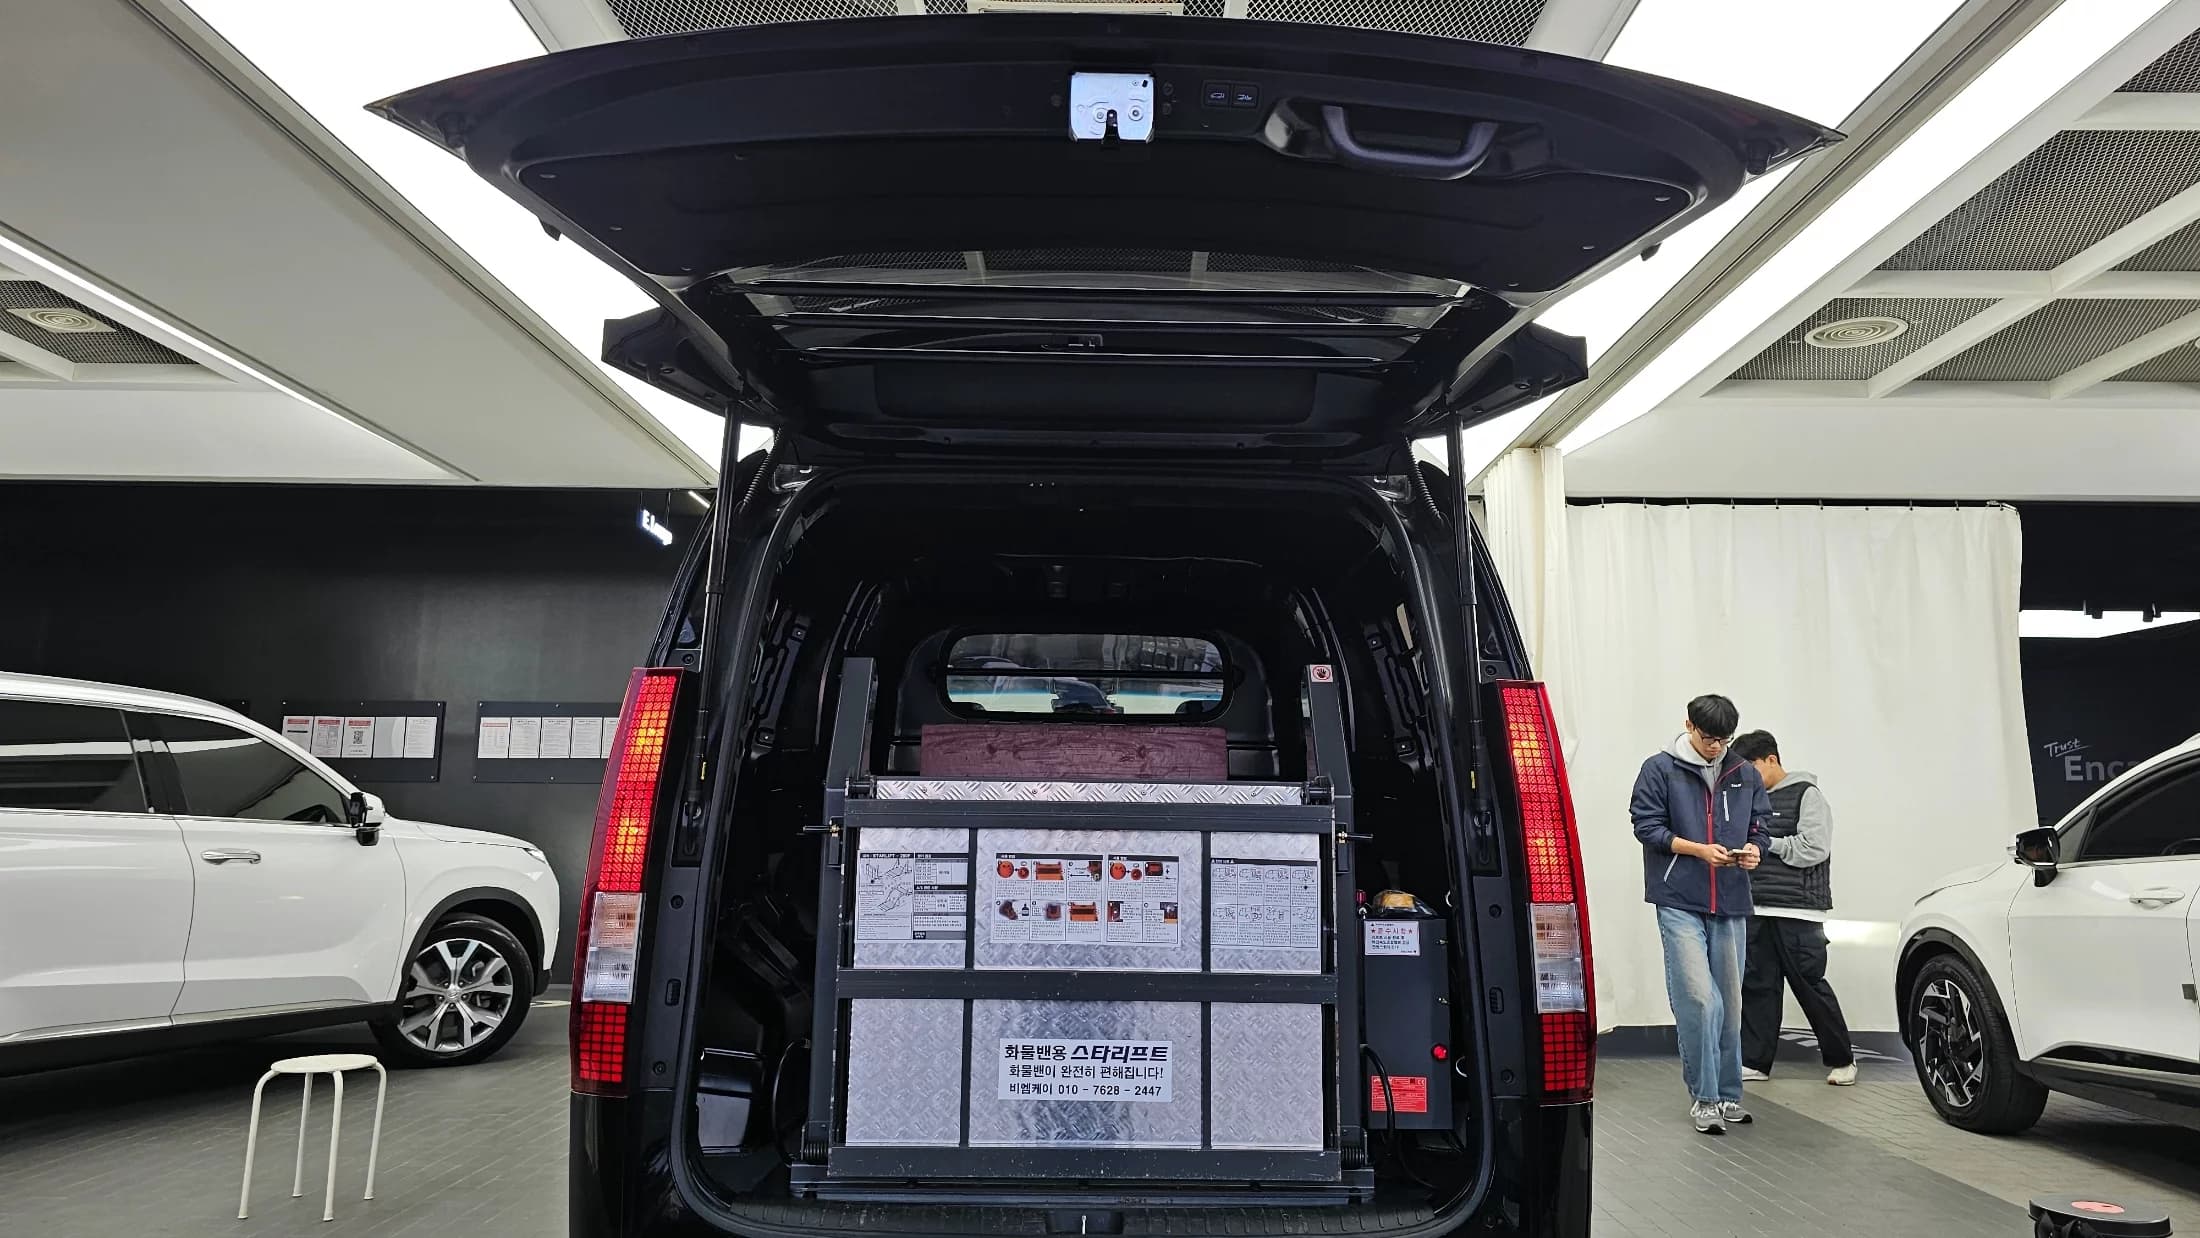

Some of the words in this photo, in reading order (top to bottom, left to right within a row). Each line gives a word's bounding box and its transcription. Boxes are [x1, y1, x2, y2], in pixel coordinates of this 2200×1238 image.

[2043, 738, 2081, 758] Trust
[2064, 755, 2140, 781] Enc
[1004, 1044, 1067, 1061] 화물밴용
[1071, 1045, 1168, 1063] 스타리프트
[1009, 1065, 1056, 1079] 화물밴이
[1061, 1065, 1096, 1079] 완전히
[1100, 1066, 1164, 1080] 편해집니다!
[1009, 1083, 1053, 1095] 비엠케이
[1058, 1084, 1078, 1095] 010
[1093, 1085, 1120, 1095] 7628
[1134, 1085, 1162, 1096] 2447
